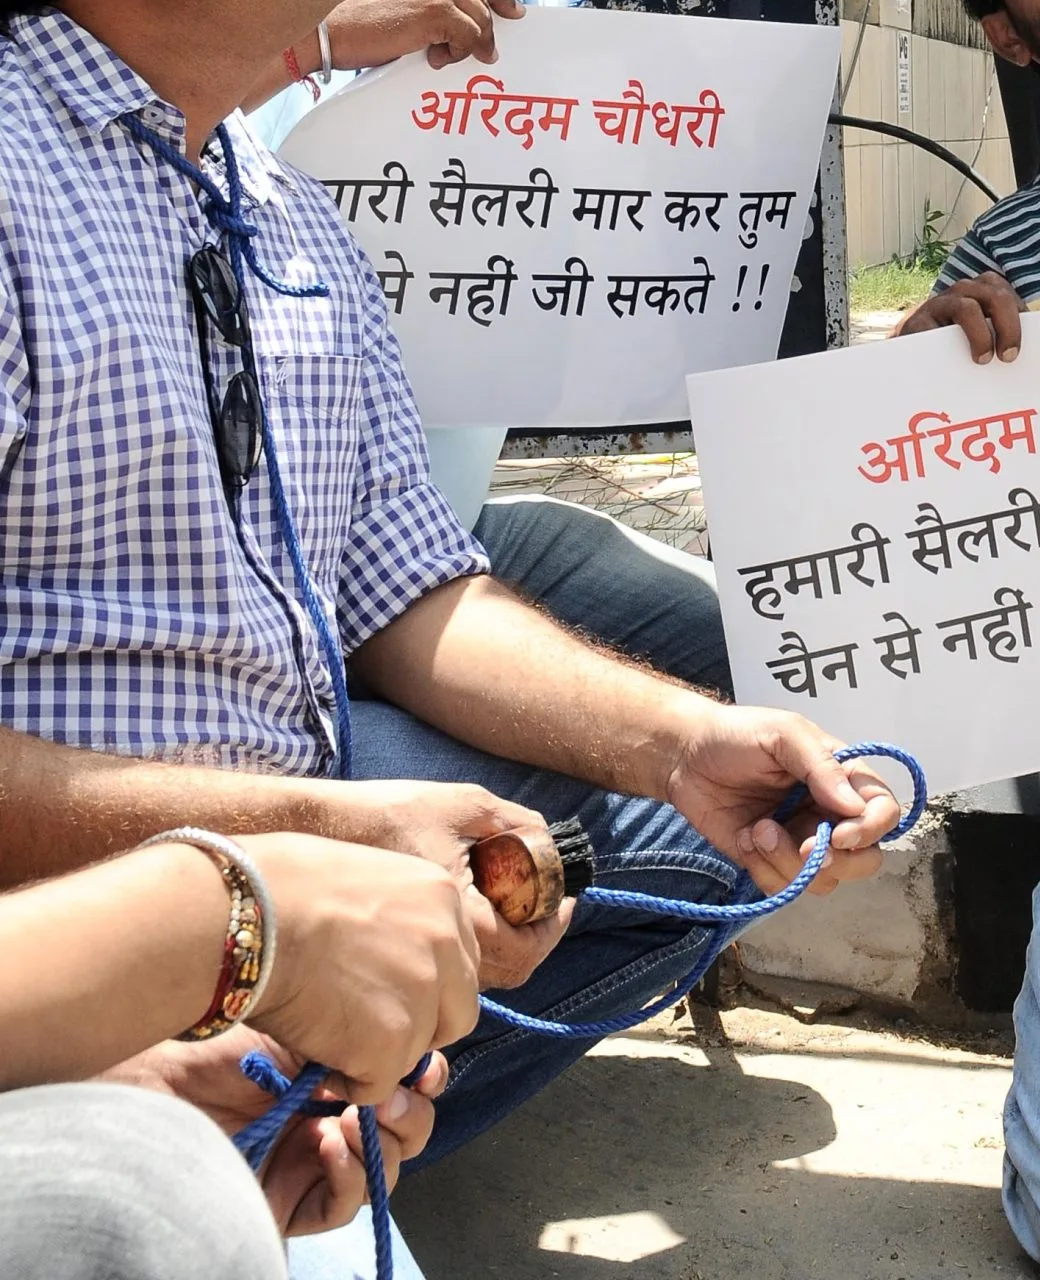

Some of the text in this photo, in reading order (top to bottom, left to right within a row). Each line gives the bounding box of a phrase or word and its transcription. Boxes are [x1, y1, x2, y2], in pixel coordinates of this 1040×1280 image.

[412, 74, 725, 150] अरिंदम चौधरी
[429, 157, 560, 228] सैलरी
[573, 187, 652, 233] मार
[664, 191, 729, 233] कर
[738, 191, 797, 250] तुम
[429, 254, 519, 328] नहीं
[531, 256, 595, 317] जी
[606, 256, 716, 318] सकते
[858, 410, 1038, 485] अरिंदम
[737, 522, 891, 621] हमारी
[765, 630, 859, 698] चैन
[873, 612, 922, 680] से
[935, 587, 1034, 664] नहीं
